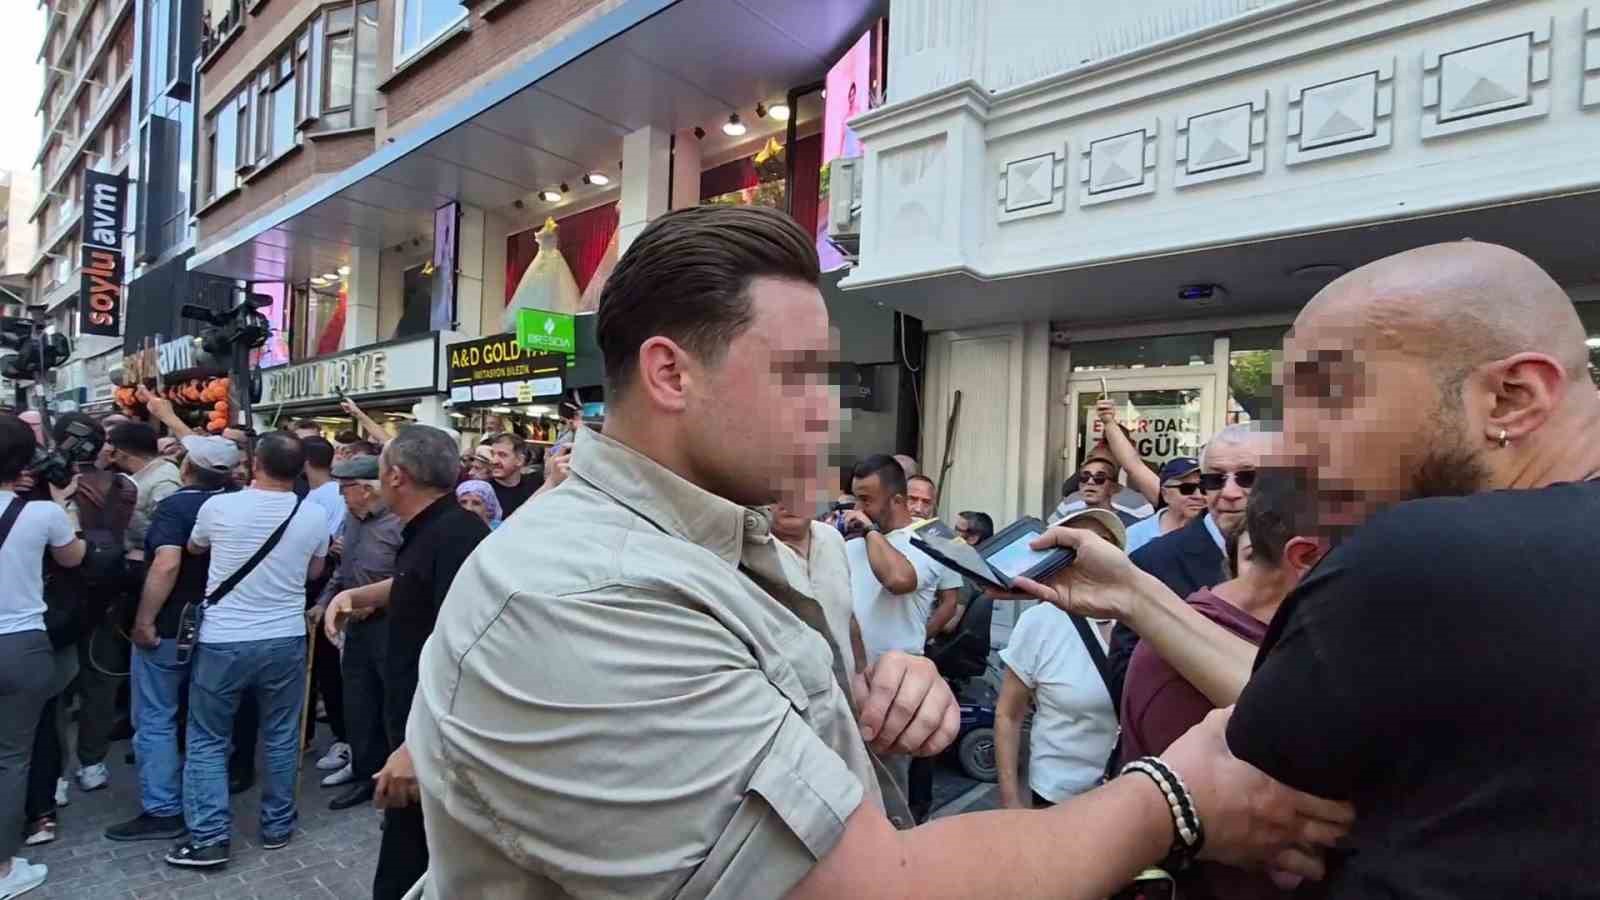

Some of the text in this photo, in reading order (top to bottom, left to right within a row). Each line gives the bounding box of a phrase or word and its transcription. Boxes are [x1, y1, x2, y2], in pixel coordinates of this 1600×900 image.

[81, 182, 121, 326] soylu avm
[451, 347, 480, 369] A&D
[482, 339, 520, 364] GOLD
